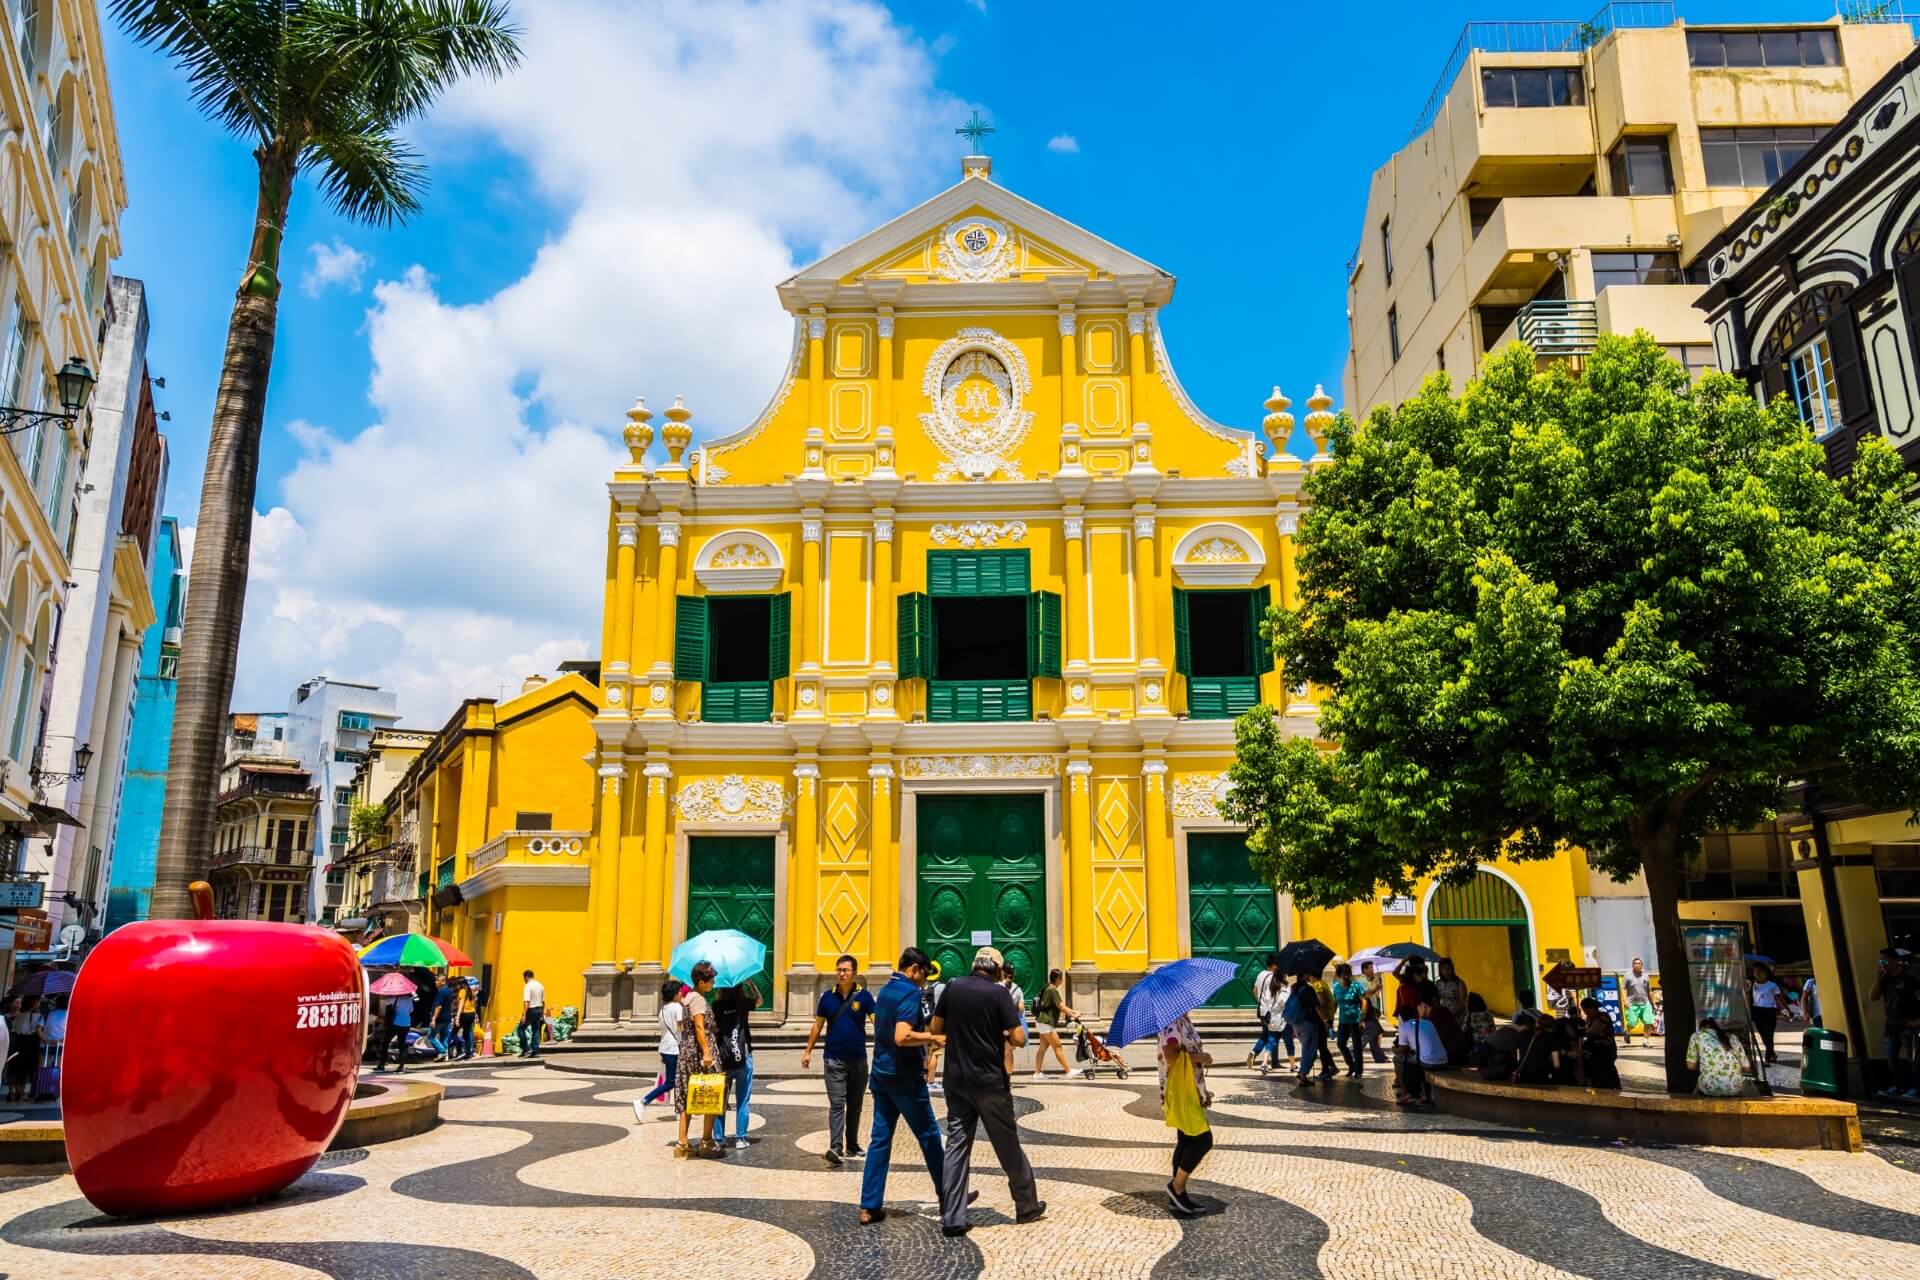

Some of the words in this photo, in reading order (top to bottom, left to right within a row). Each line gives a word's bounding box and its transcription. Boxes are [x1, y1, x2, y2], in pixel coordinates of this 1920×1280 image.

[296, 1004, 338, 1029] 2833
[340, 1002, 361, 1025] 8181
[731, 1028, 741, 1062] adidas
